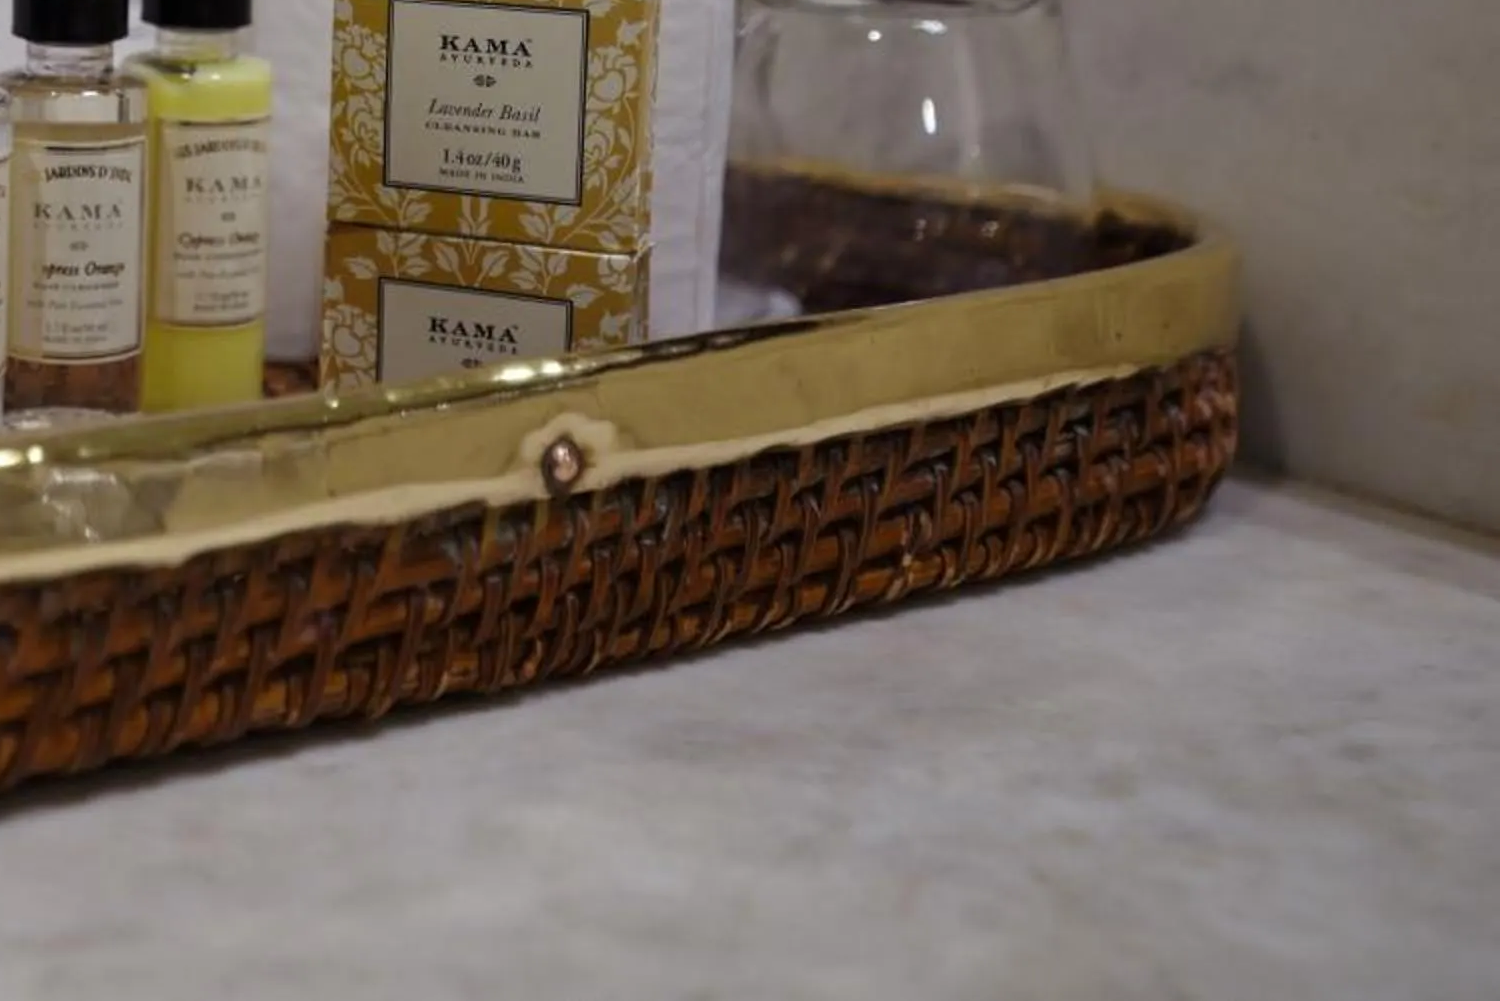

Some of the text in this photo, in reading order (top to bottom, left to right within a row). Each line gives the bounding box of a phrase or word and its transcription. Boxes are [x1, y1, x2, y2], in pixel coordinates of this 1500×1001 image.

[440, 34, 532, 57] KAMA
[440, 54, 533, 68] AYURVEDA
[428, 98, 542, 123] Lavender Basil
[425, 121, 506, 136] CLEANSING
[185, 176, 262, 194] KAMA
[33, 202, 122, 221] KAMA
[428, 316, 518, 344] KAMA
[429, 335, 518, 355] AYURVEDA
